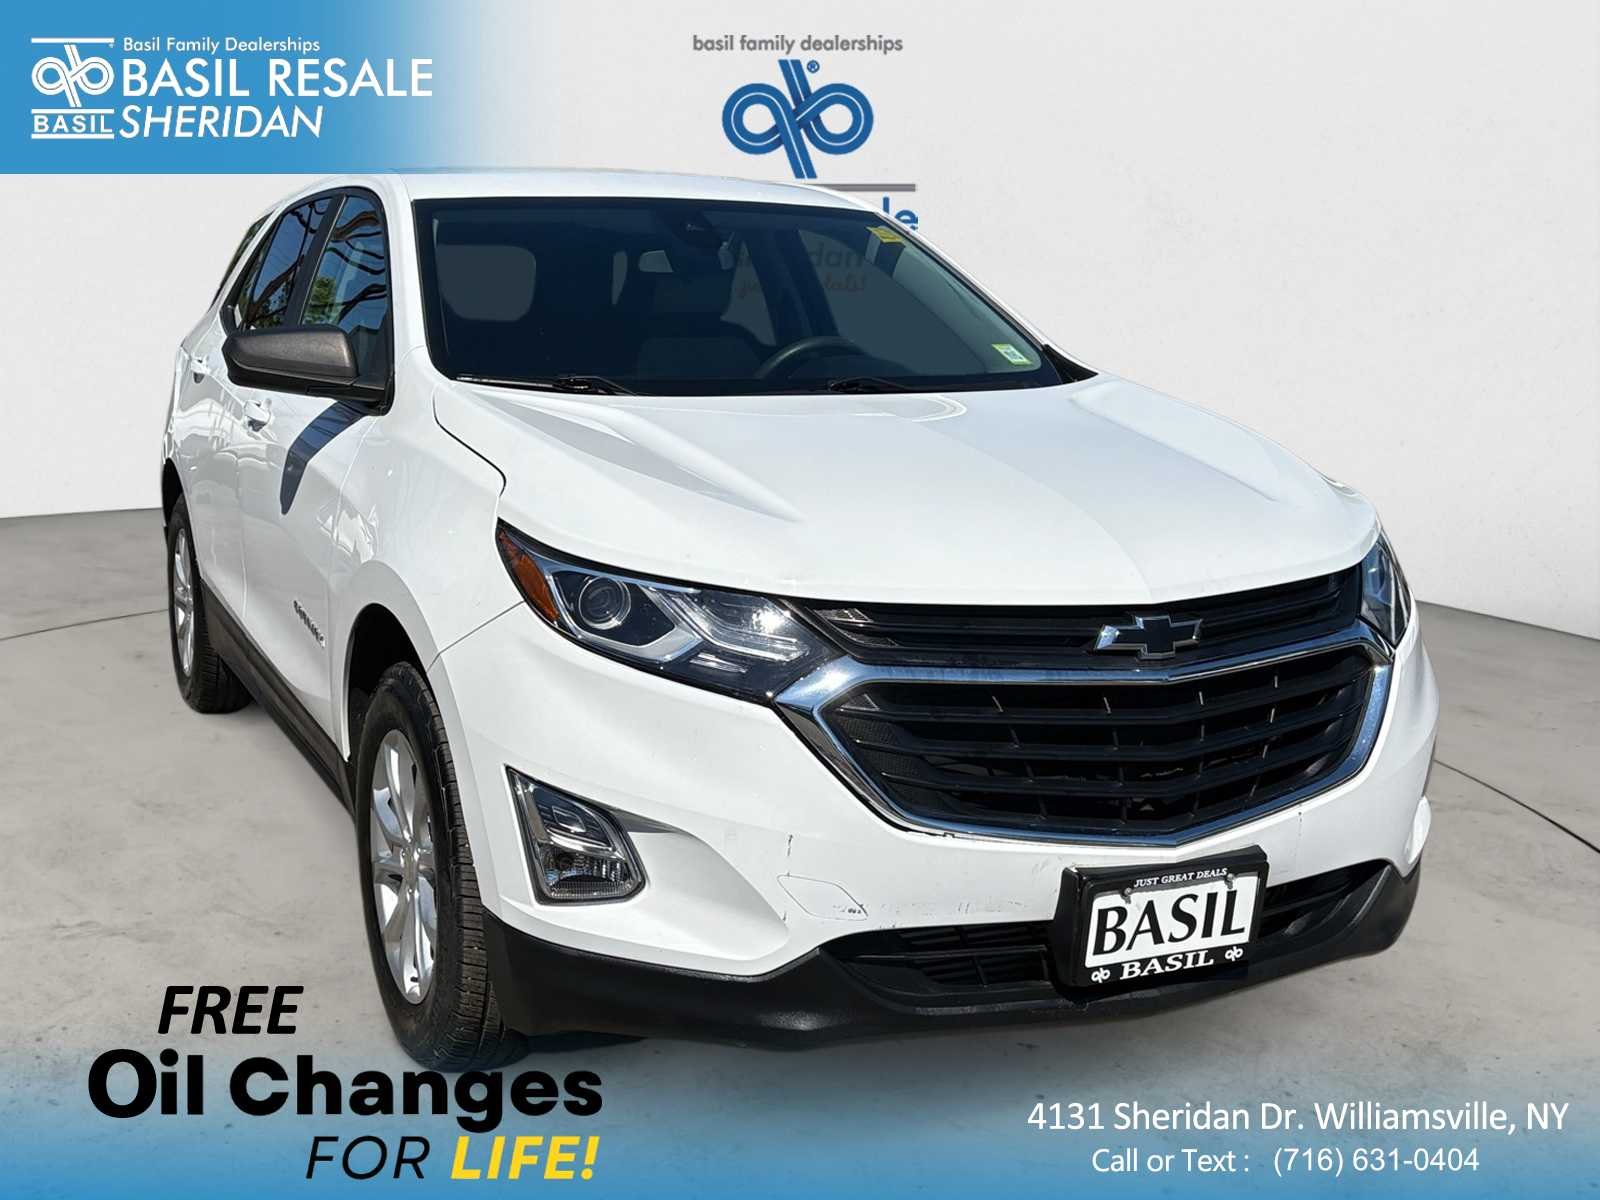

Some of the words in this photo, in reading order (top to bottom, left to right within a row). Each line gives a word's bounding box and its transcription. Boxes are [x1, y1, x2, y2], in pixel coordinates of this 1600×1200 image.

[692, 34, 734, 52] basil
[739, 34, 796, 55] family
[800, 34, 904, 55] dealerships
[1134, 877, 1159, 888] JUST
[1161, 872, 1193, 885] GREAT
[1196, 867, 1228, 881] DEALS
[1092, 889, 1246, 957] BASIL
[1119, 950, 1215, 981] BASIL
